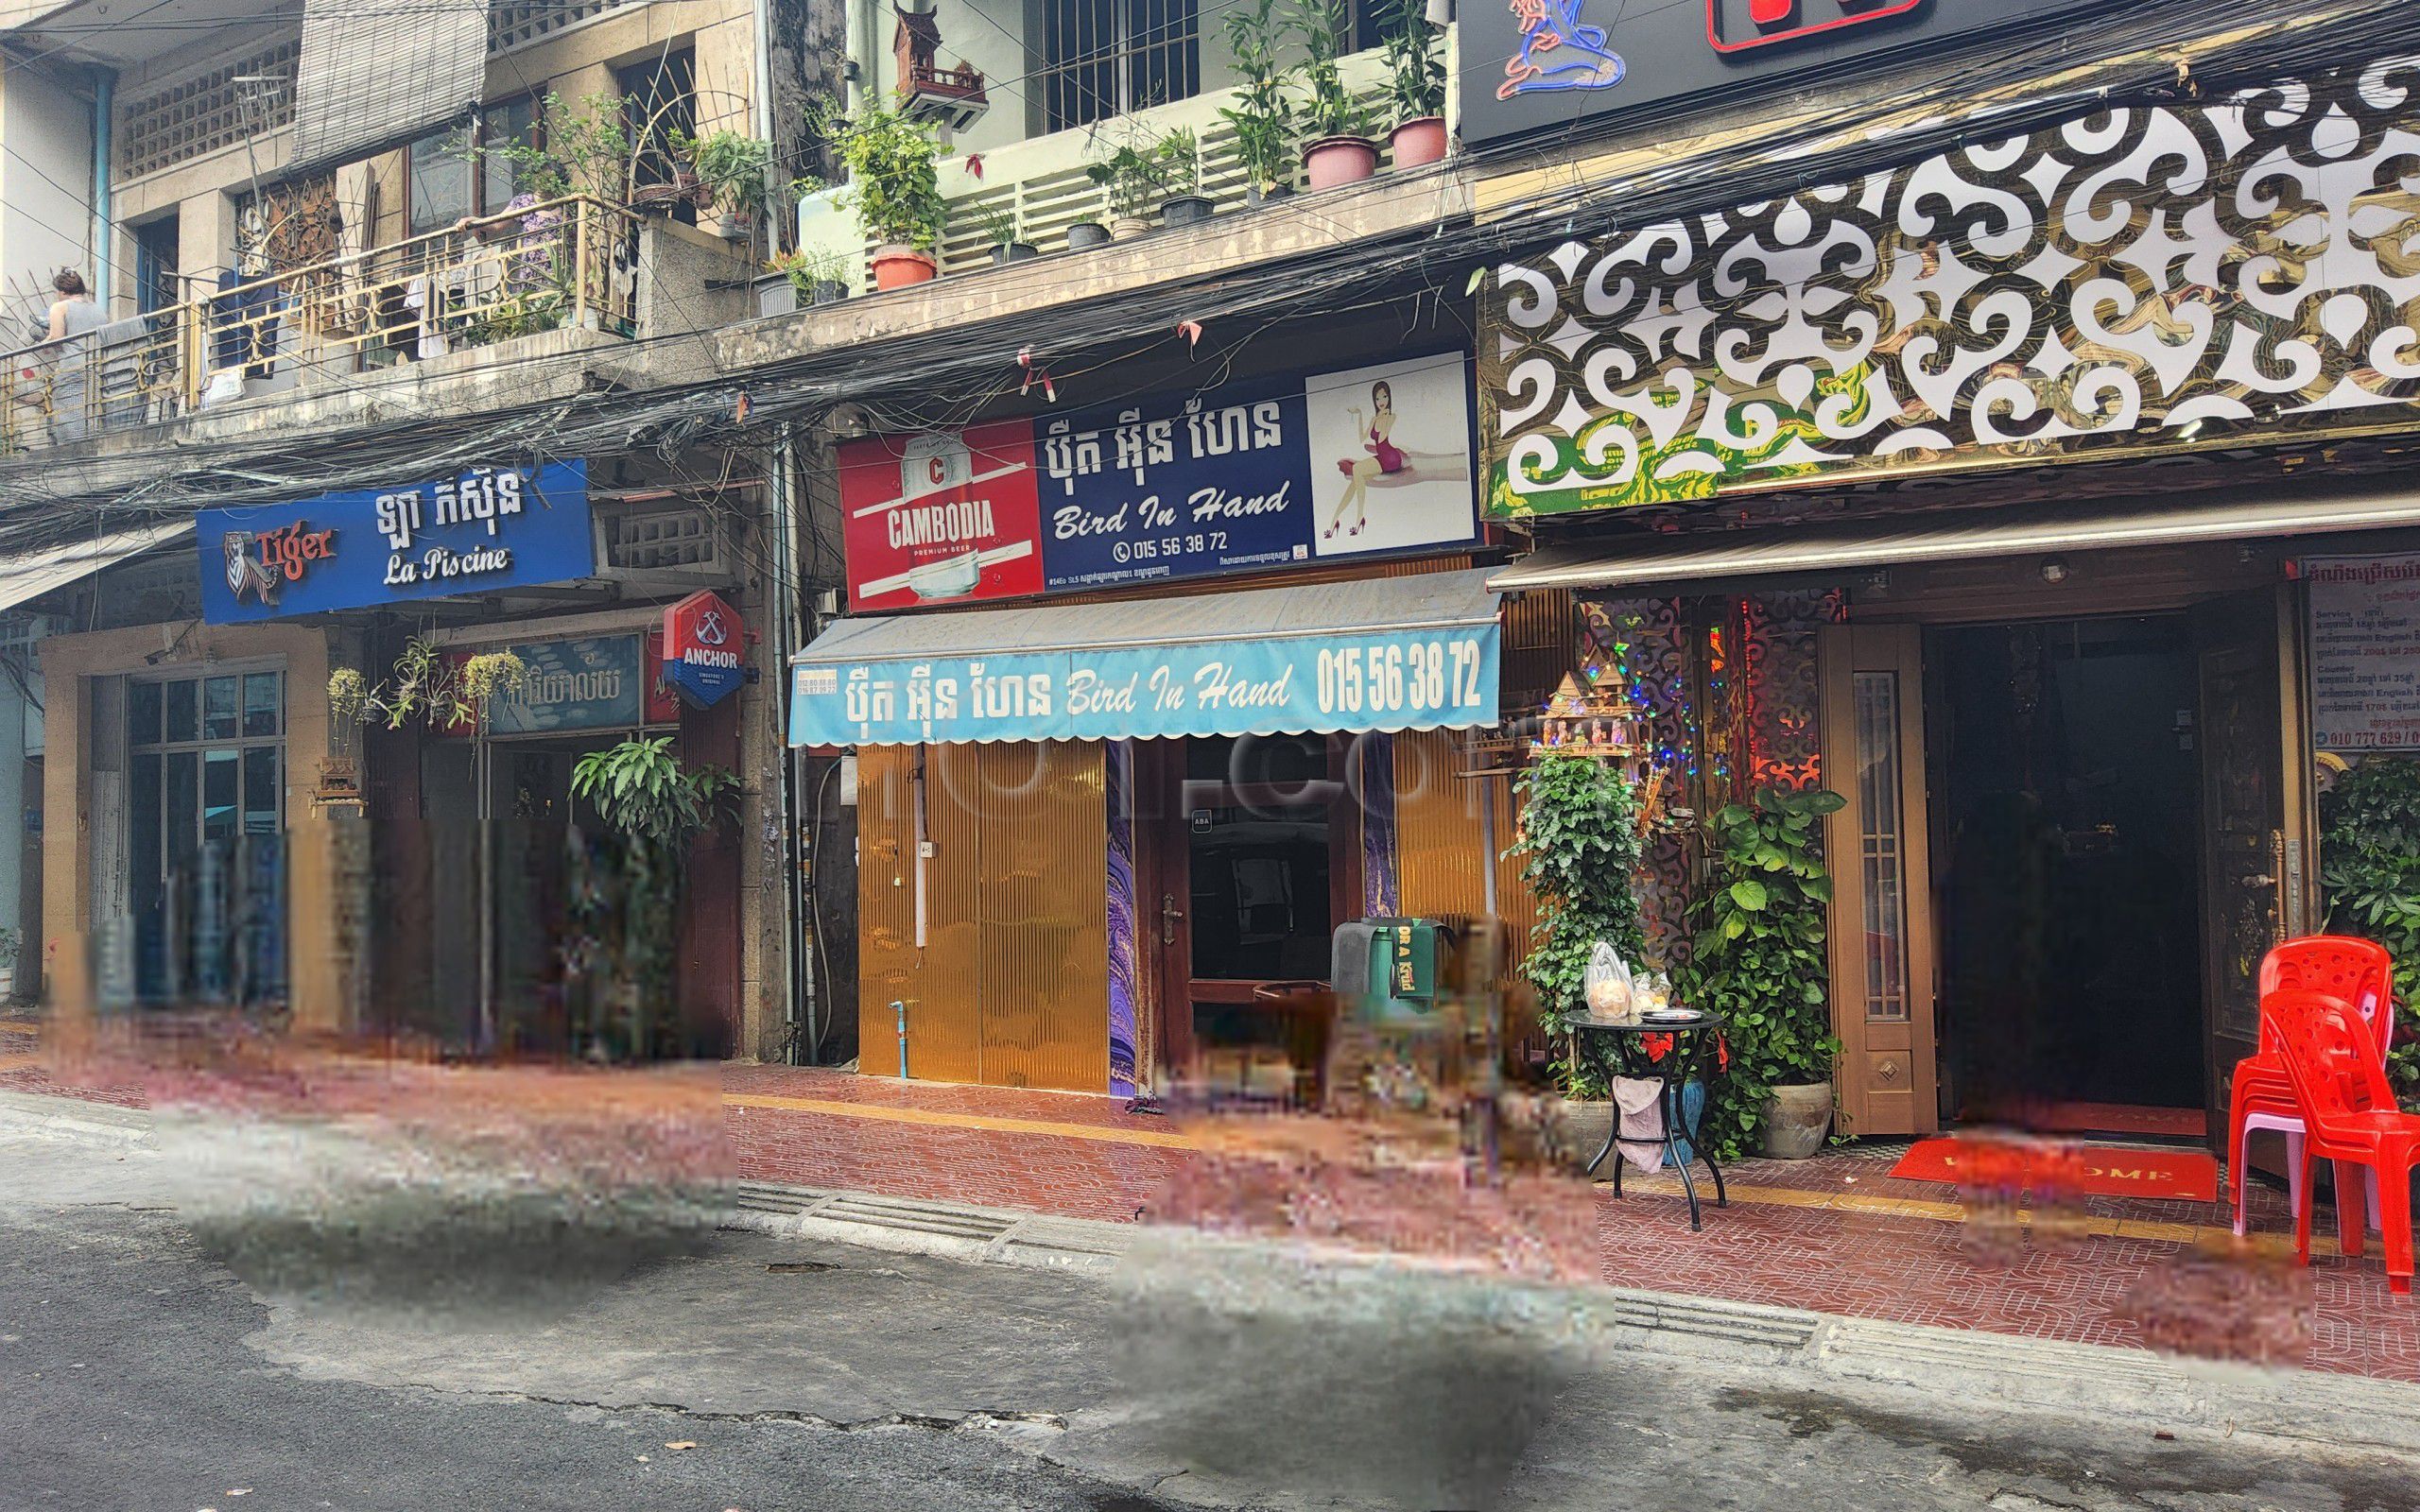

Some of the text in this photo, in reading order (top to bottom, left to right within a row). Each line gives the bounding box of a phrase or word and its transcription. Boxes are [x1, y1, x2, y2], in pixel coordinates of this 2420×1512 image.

[1053, 480, 1291, 540] Bird In Hand
[888, 500, 995, 550] CAMBODIA
[255, 519, 335, 580] Tiger
[913, 544, 971, 557] PREMIUM BEER
[1133, 531, 1228, 559] 015 56 38 72
[383, 544, 509, 585] La Piscine
[2375, 633, 2411, 643] English
[683, 647, 738, 669] ANCHOR
[2317, 665, 2355, 674] Counter
[1065, 661, 1293, 715] Bird In Hand
[1317, 638, 1481, 714] 015 56 38 72
[2376, 689, 2413, 698] English
[2329, 731, 2352, 746] 010
[2355, 731, 2377, 746] 777
[2379, 730, 2402, 745] 629
